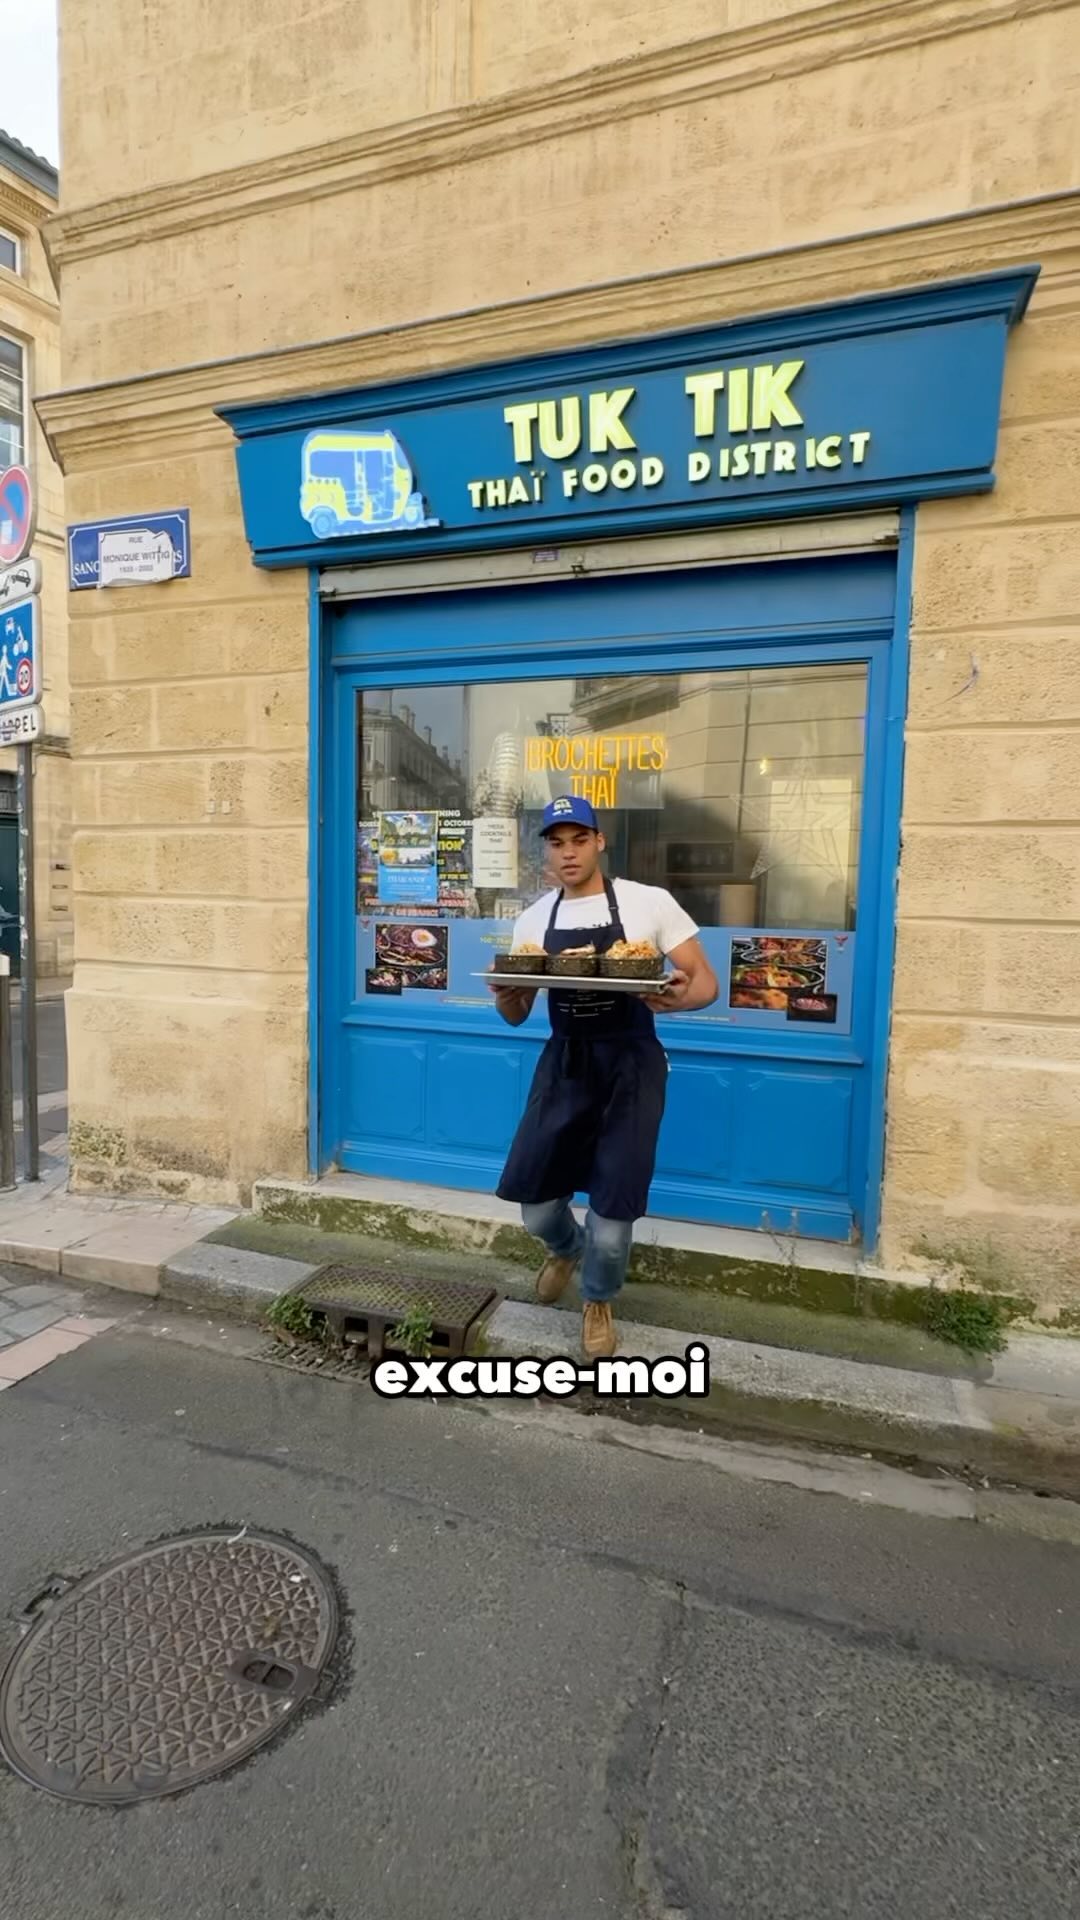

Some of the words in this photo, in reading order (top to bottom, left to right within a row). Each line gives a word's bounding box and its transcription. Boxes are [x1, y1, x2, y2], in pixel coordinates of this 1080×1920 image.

[504, 387, 637, 464] TUK
[685, 359, 805, 438] TIK
[467, 470, 546, 509] THAÏ
[563, 456, 665, 498] FOOD
[688, 431, 871, 483] DISTRICT
[103, 552, 140, 563] MONIQUE
[526, 734, 667, 772] BROCHETTES
[569, 767, 619, 809] THAÏ
